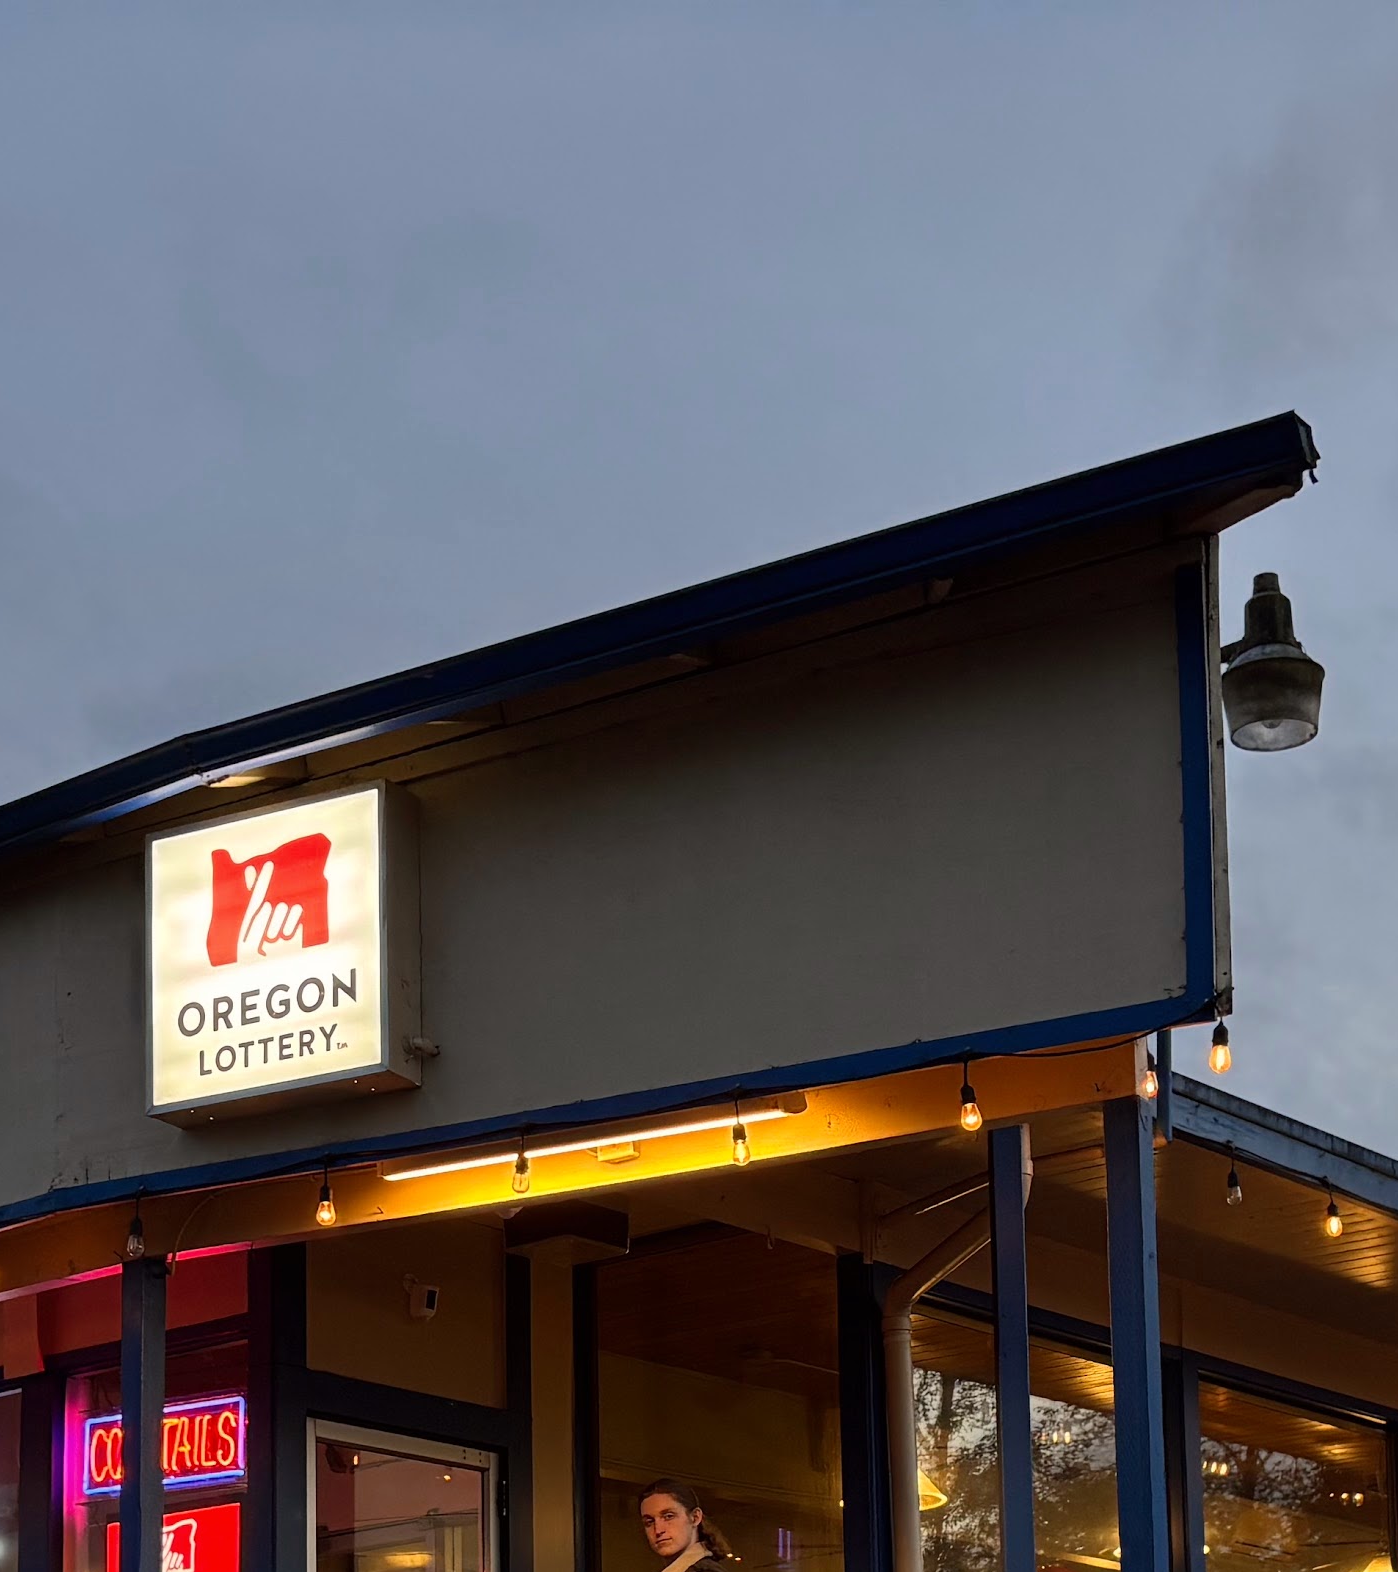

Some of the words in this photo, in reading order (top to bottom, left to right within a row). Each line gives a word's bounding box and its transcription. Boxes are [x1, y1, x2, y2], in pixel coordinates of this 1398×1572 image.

[178, 968, 357, 1037] OREGON
[199, 1023, 338, 1076] LOTTERY
[89, 1411, 238, 1482] COTAILS
